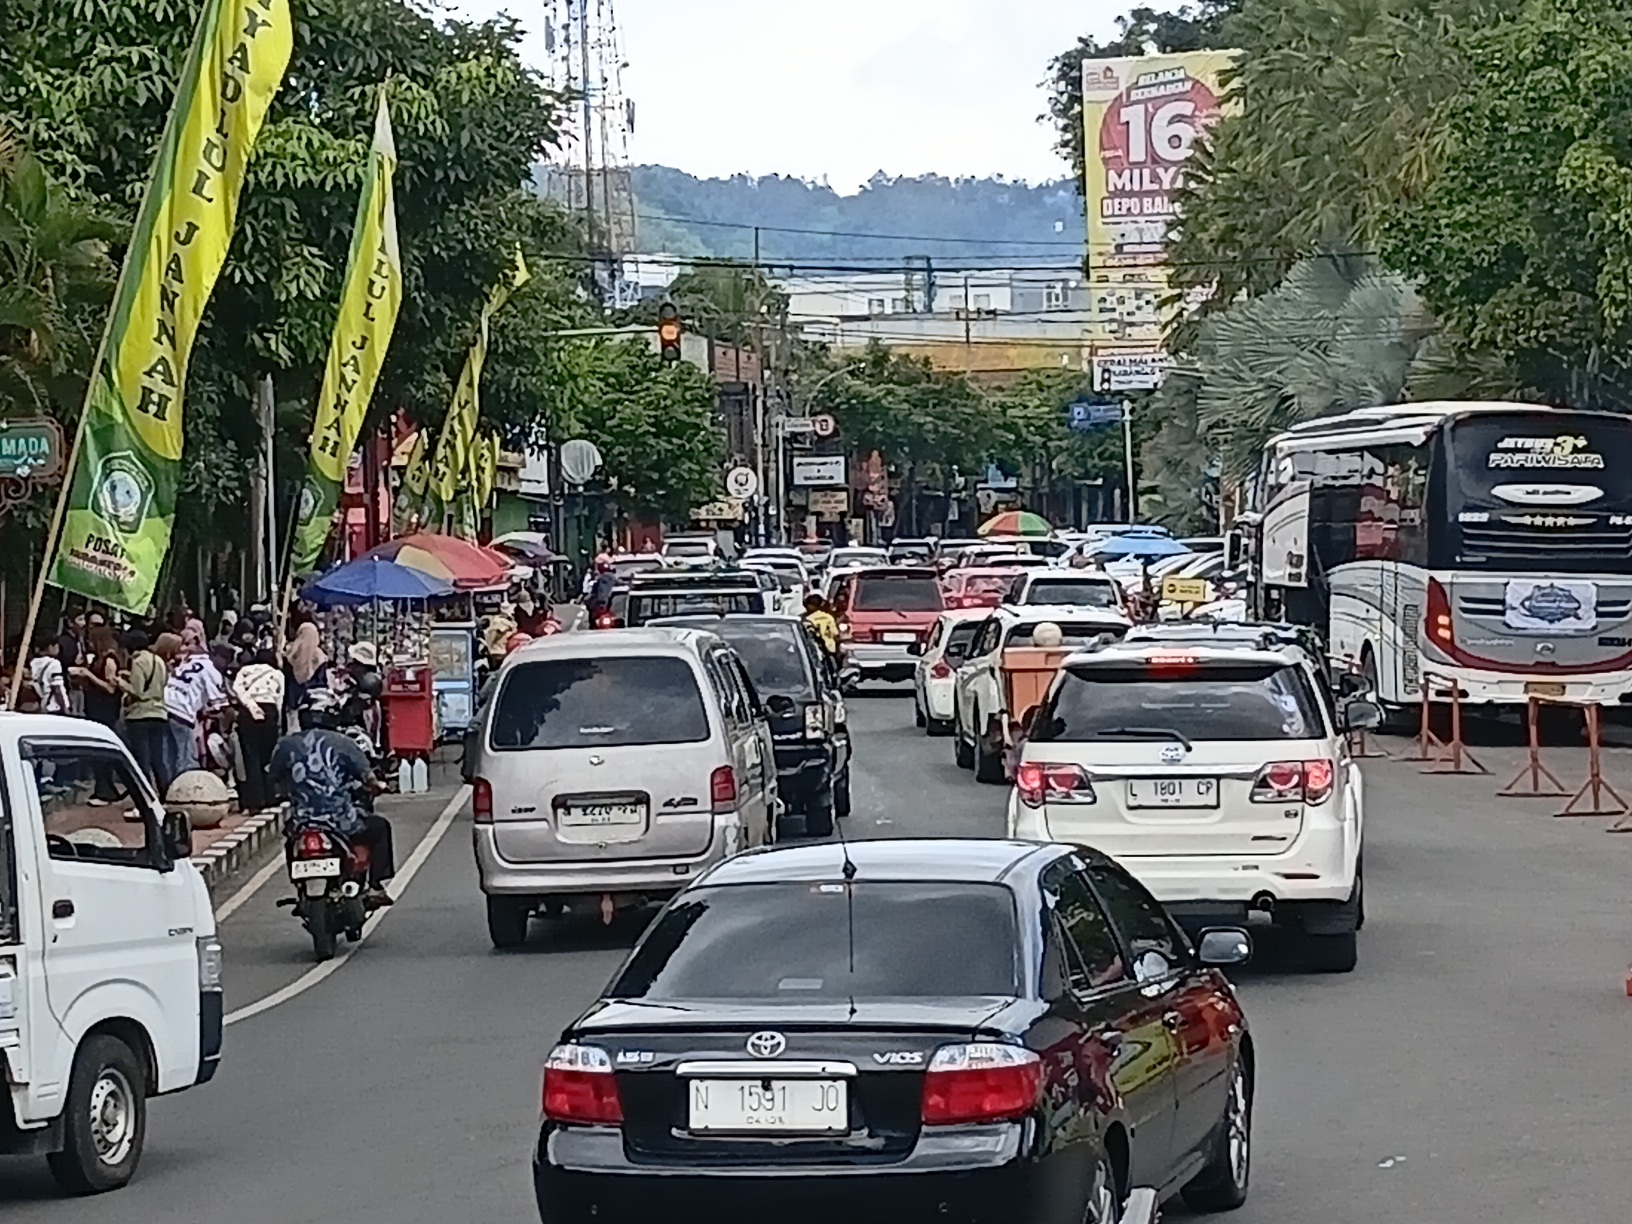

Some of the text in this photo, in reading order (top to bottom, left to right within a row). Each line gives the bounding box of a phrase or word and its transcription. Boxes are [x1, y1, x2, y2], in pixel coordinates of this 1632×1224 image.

[1120, 101, 1195, 163] 16
[1103, 198, 1139, 215] DEPO
[137, 221, 200, 421] JANNAH
[1, 437, 50, 455] MADA
[1129, 781, 1214, 797] L 1801 CP
[873, 1051, 924, 1064] VIOS
[695, 1085, 708, 1111] N
[738, 1084, 786, 1112] 1591
